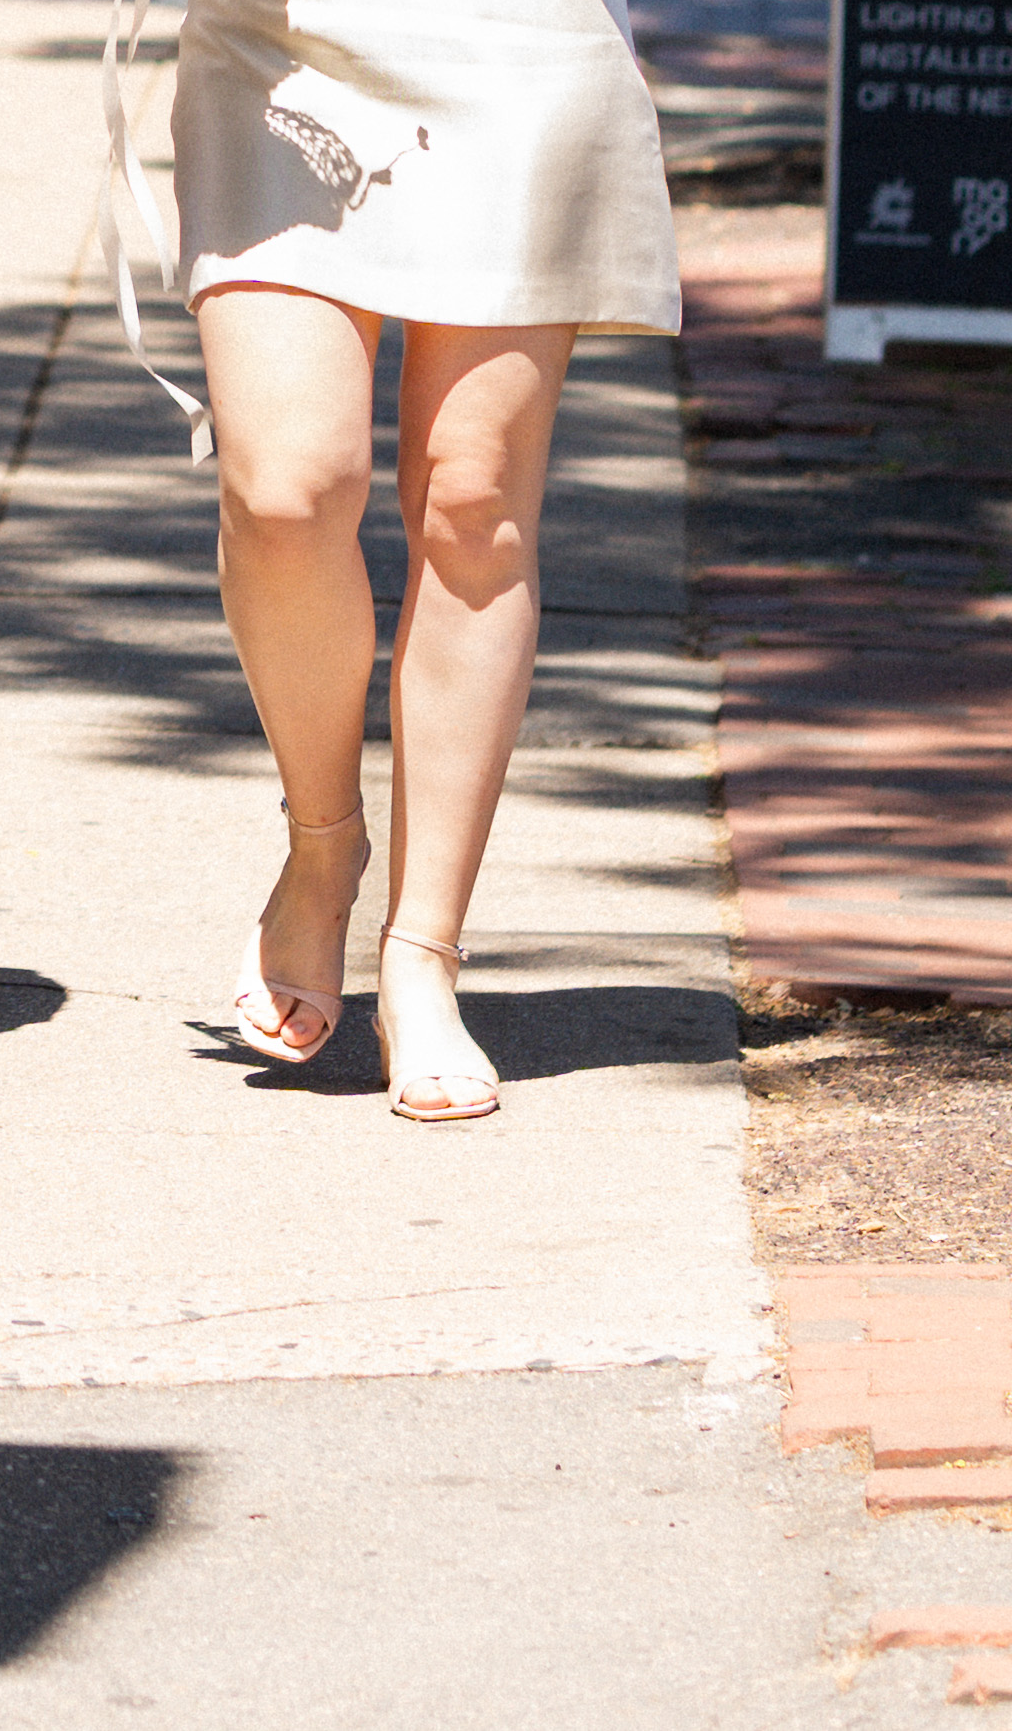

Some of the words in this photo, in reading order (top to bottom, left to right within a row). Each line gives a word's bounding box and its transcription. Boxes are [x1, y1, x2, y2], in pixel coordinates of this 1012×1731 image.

[861, 4, 993, 32] LIGHTING
[859, 83, 894, 109] OF
[908, 85, 958, 111] THE
